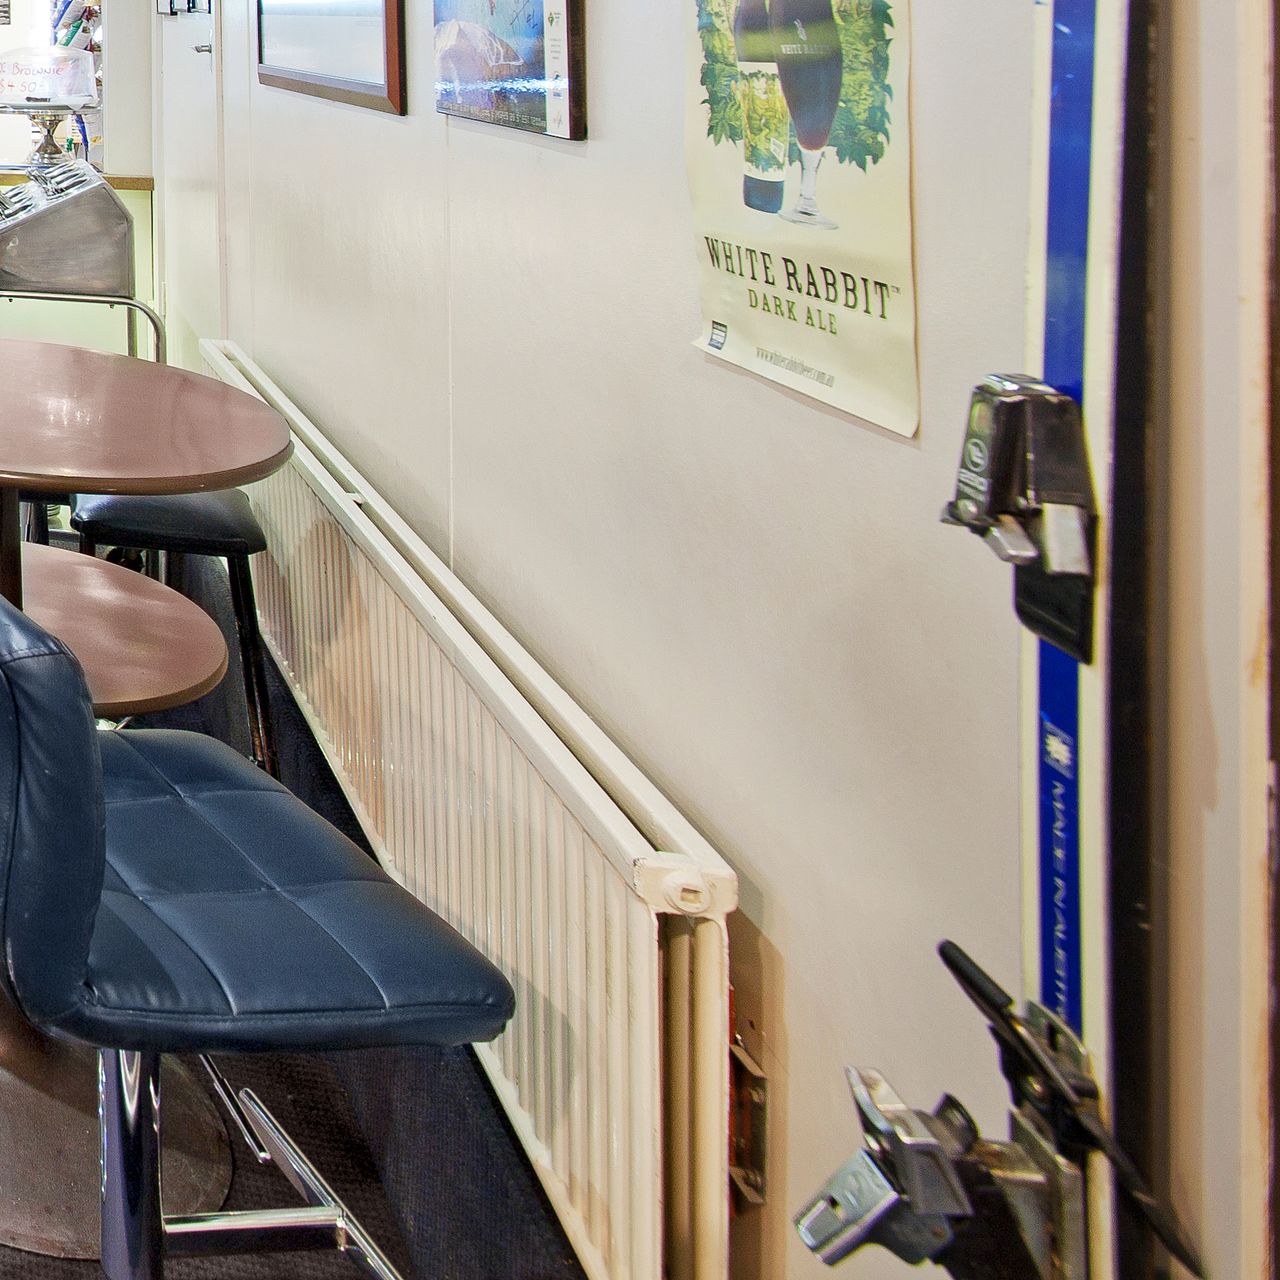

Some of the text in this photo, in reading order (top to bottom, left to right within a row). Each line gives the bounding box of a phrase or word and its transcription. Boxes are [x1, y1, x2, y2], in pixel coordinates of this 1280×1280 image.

[704, 236, 776, 286] WHITE
[782, 256, 890, 320] RABBIT
[747, 288, 838, 336] DARK ALE
[1051, 780, 1068, 872] MADE
